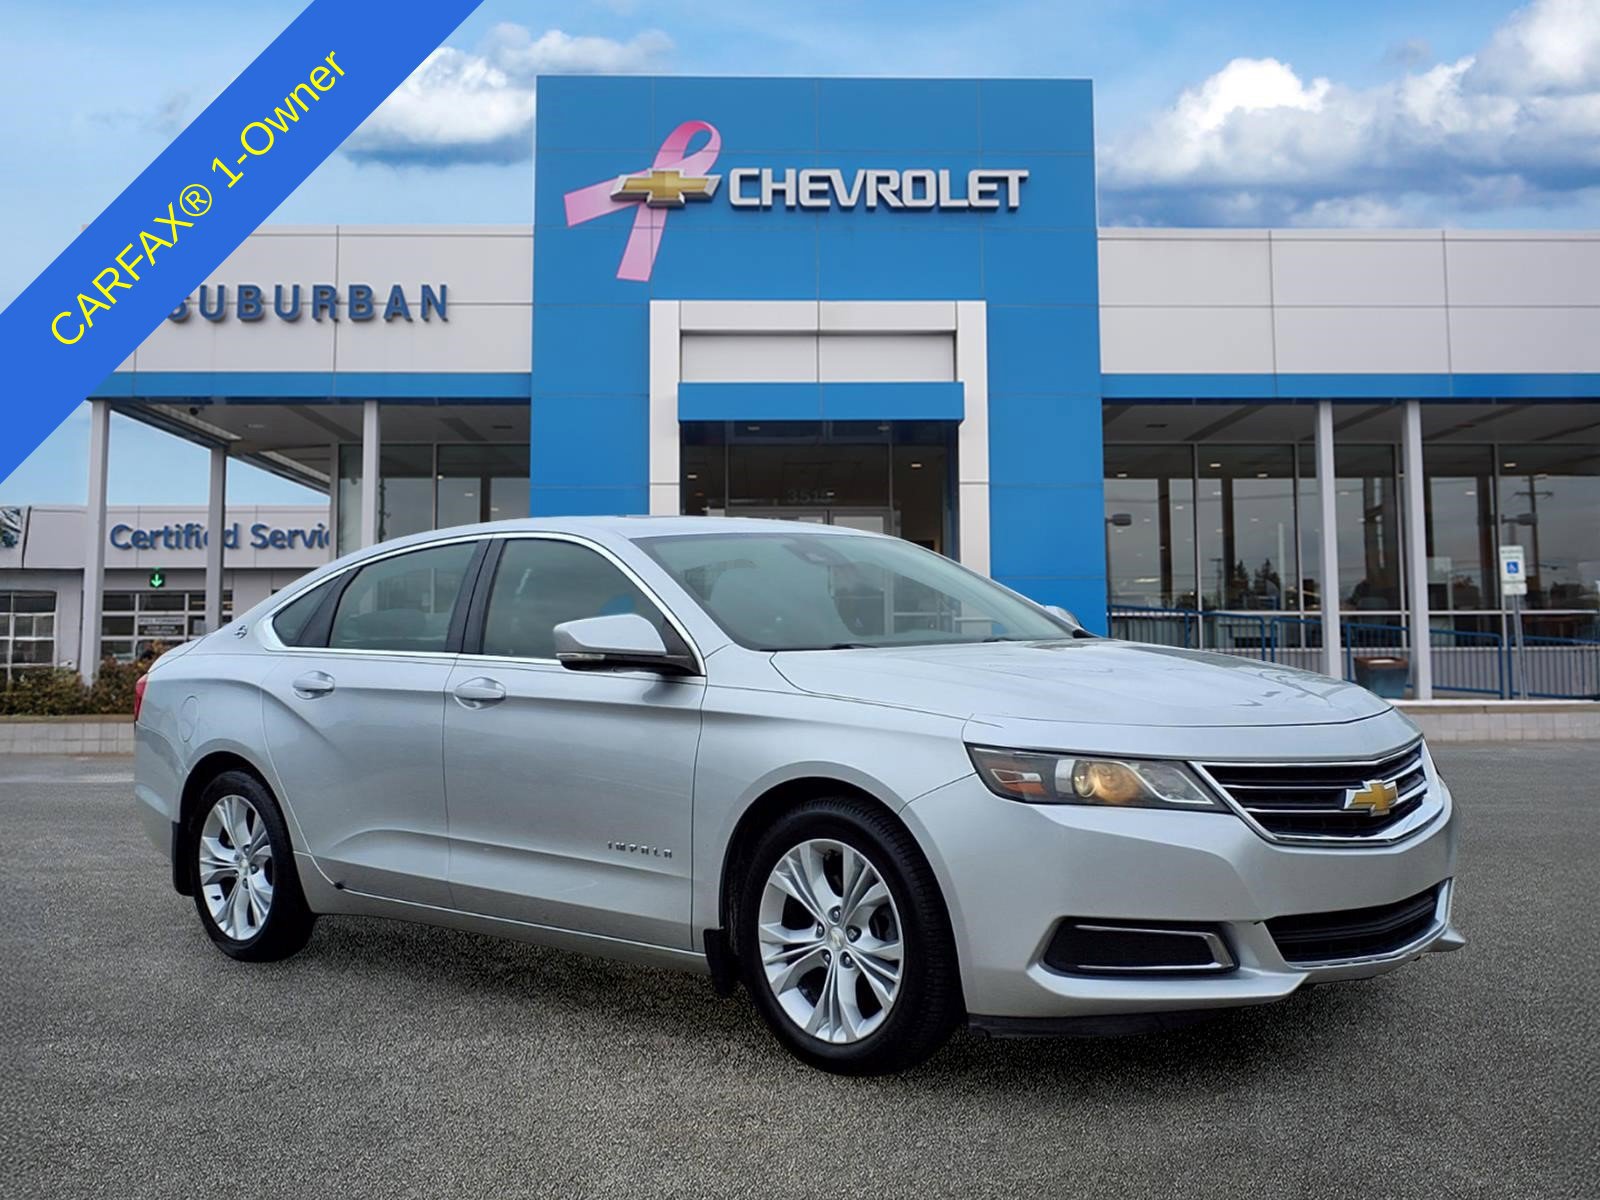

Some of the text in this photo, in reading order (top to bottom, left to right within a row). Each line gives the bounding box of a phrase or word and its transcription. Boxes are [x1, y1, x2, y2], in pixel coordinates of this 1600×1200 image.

[730, 167, 1029, 209] CHEVROLET
[110, 523, 330, 550] Certifid Servi
